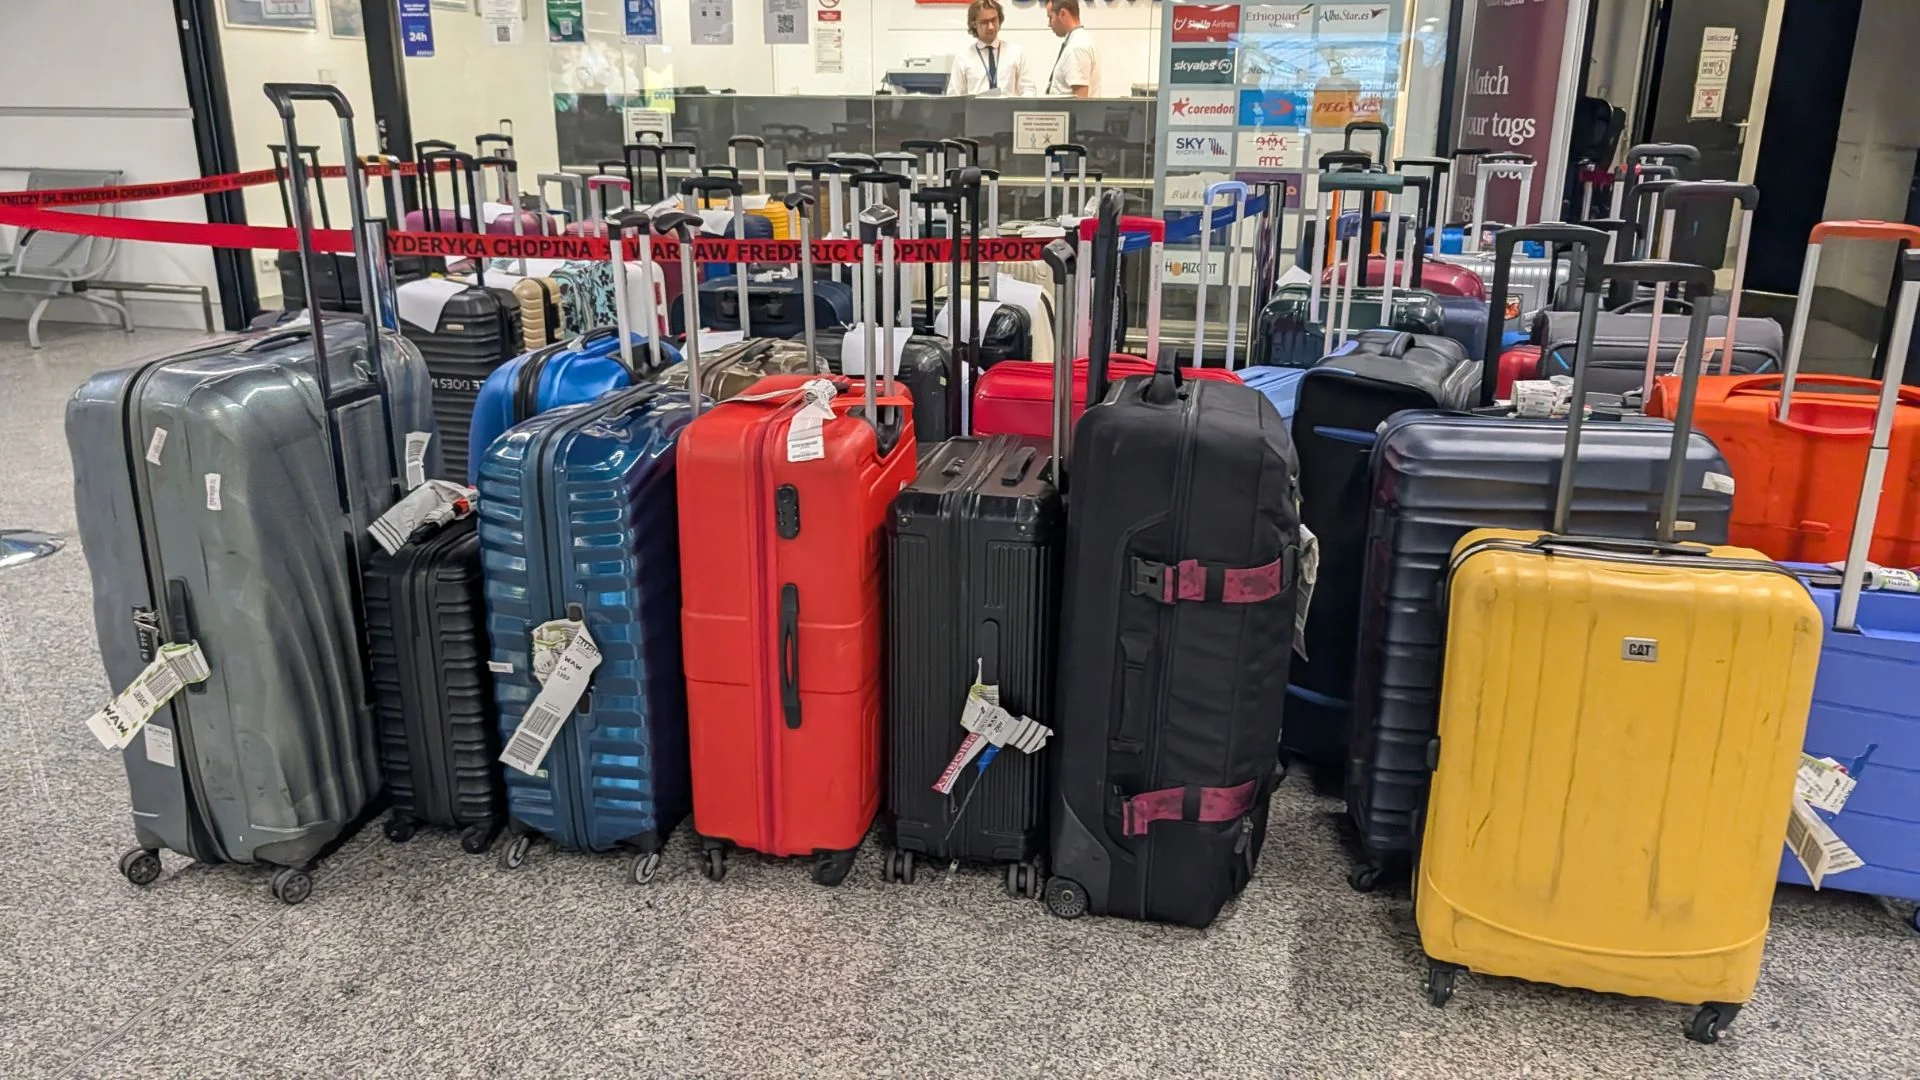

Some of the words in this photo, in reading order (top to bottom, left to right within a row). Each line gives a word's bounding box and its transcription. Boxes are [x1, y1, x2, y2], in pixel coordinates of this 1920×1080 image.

[409, 32, 428, 42] 24h
[1173, 60, 1216, 72] skyalps
[1188, 103, 1236, 115] corendon
[1491, 112, 1536, 146] tags
[1176, 137, 1206, 149] SKY
[493, 239, 593, 258] CHOPINA
[629, 242, 729, 260] WARAW
[737, 243, 847, 261] FREDERIC
[440, 377, 471, 391] DOES
[1629, 643, 1652, 656] CAT
[564, 655, 583, 671] WAW
[103, 703, 129, 734] WAW
[935, 733, 979, 791] PRIORITY
